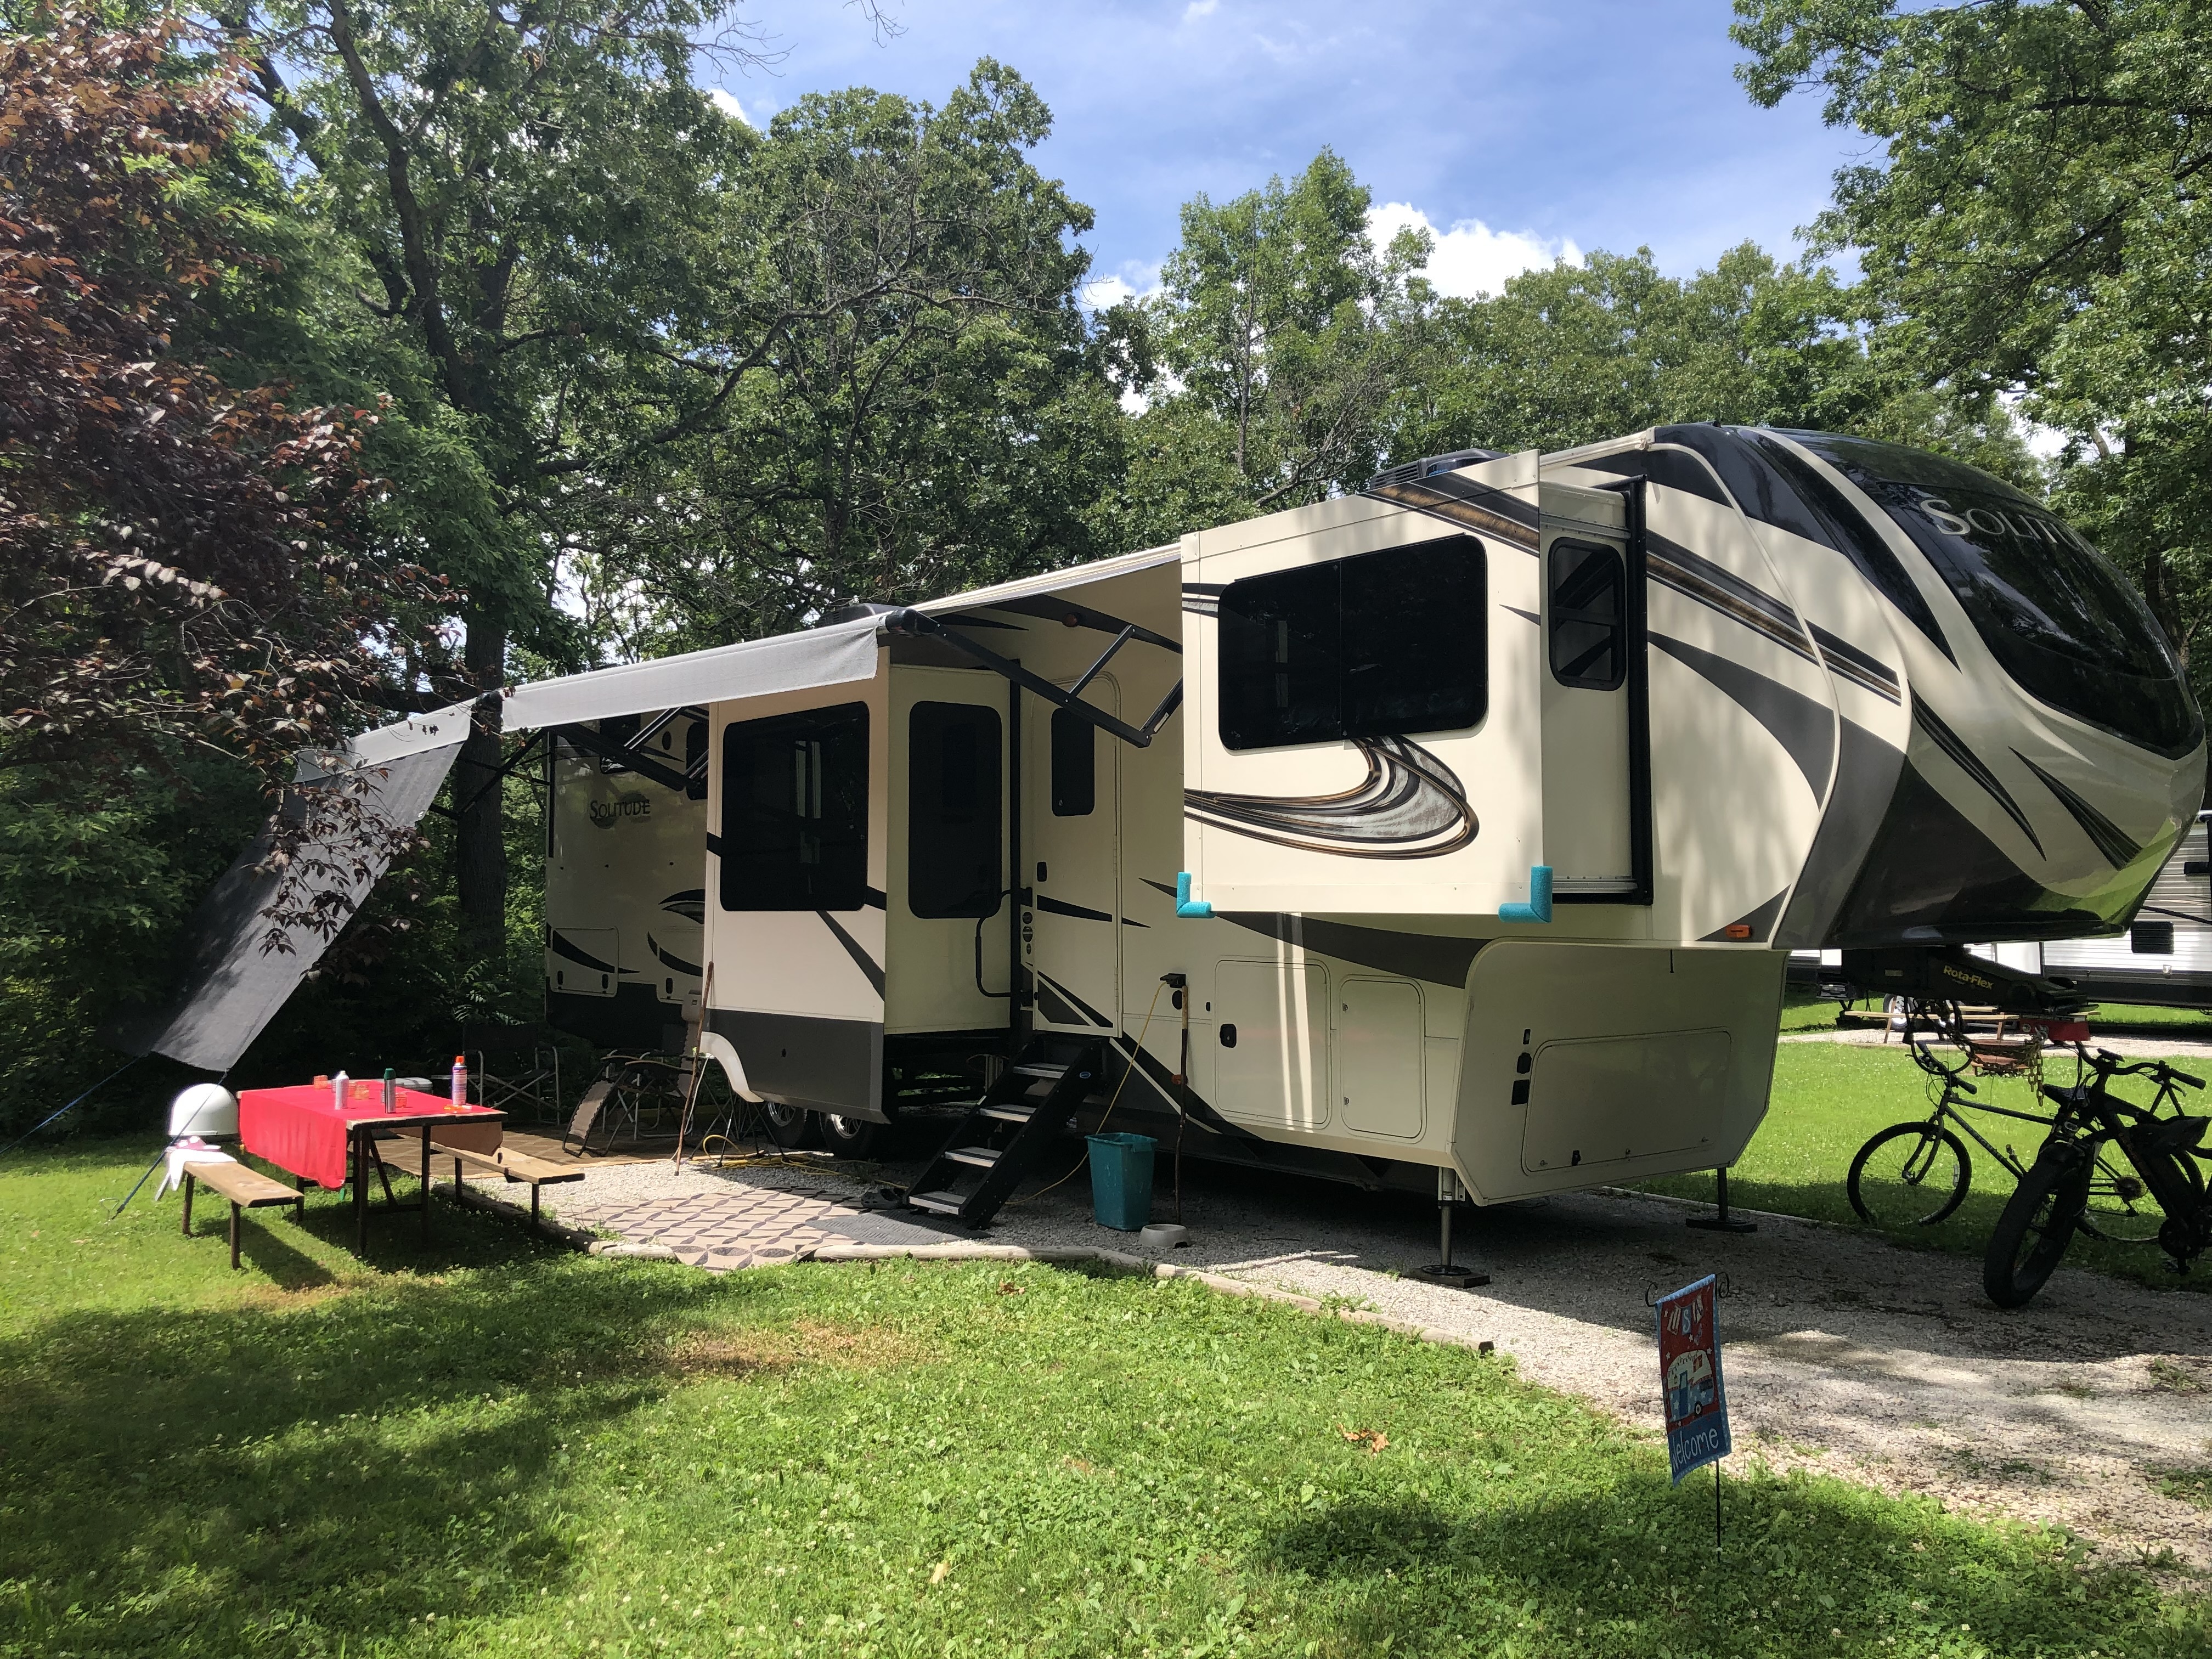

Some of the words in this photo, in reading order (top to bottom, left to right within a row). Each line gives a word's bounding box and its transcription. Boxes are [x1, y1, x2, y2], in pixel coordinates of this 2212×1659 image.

[1920, 499, 2081, 551] SOLITU
[590, 799, 651, 819] SOLITUDE
[1669, 1297, 1703, 1334] USA
